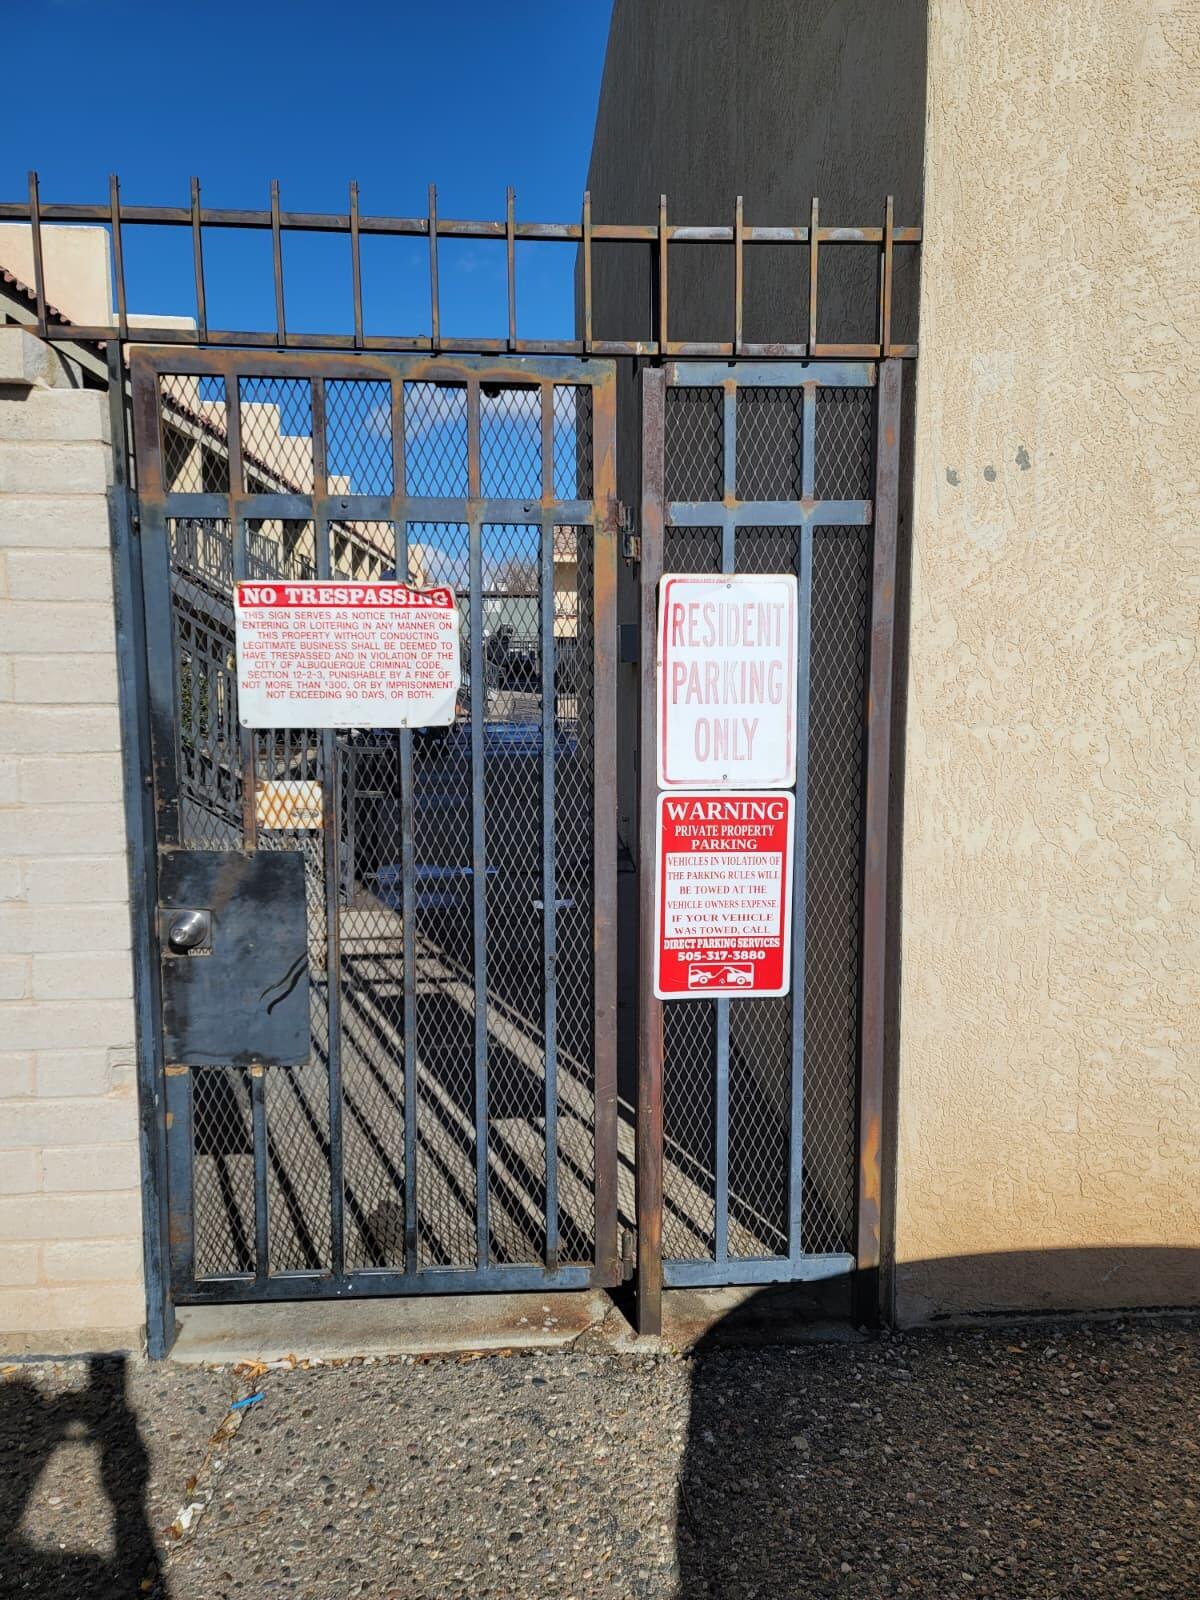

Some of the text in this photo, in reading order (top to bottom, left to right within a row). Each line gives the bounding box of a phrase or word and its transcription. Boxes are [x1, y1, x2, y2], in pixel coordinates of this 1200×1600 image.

[243, 588, 449, 606] NO TRESPASSING
[415, 612, 450, 620] ANYONE
[672, 602, 784, 648] RESIDENT
[293, 671, 325, 680] 12-2-3,
[672, 660, 784, 705] PARKING
[362, 691, 387, 700] DAYS,
[694, 717, 759, 762] ONLY
[665, 801, 785, 820] WARNING
[675, 825, 774, 836] PRIVATE PROPERTY
[691, 839, 758, 850] PARKING
[668, 856, 780, 866] VEHICLES IN VIOLATION OF
[668, 871, 779, 880] THE PARKING RULES WILL
[679, 885, 767, 895] BE TOWED AT THE
[668, 901, 703, 909] VEHICLE
[704, 900, 739, 909] OWNERS
[701, 927, 740, 935] TOWED,
[664, 938, 780, 950] DIRECT PARKING SERVICES
[677, 950, 766, 961] 505-317-3880
